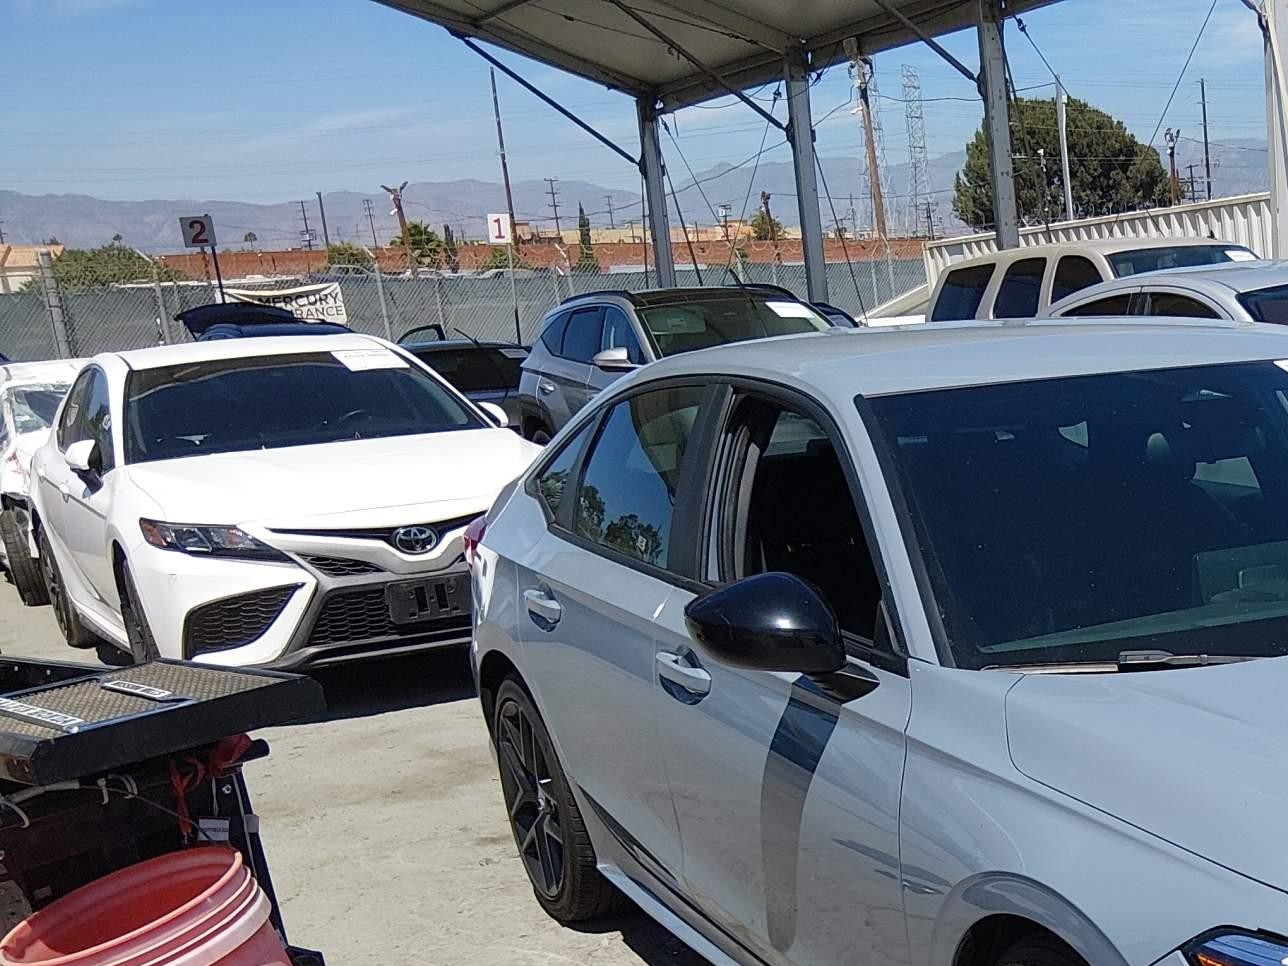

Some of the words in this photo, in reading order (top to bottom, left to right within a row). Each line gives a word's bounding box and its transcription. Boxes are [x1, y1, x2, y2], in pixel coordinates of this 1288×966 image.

[189, 220, 209, 244] 2
[493, 217, 506, 239] 1
[257, 291, 340, 308] MERCURY
[296, 305, 344, 319] RANCE
